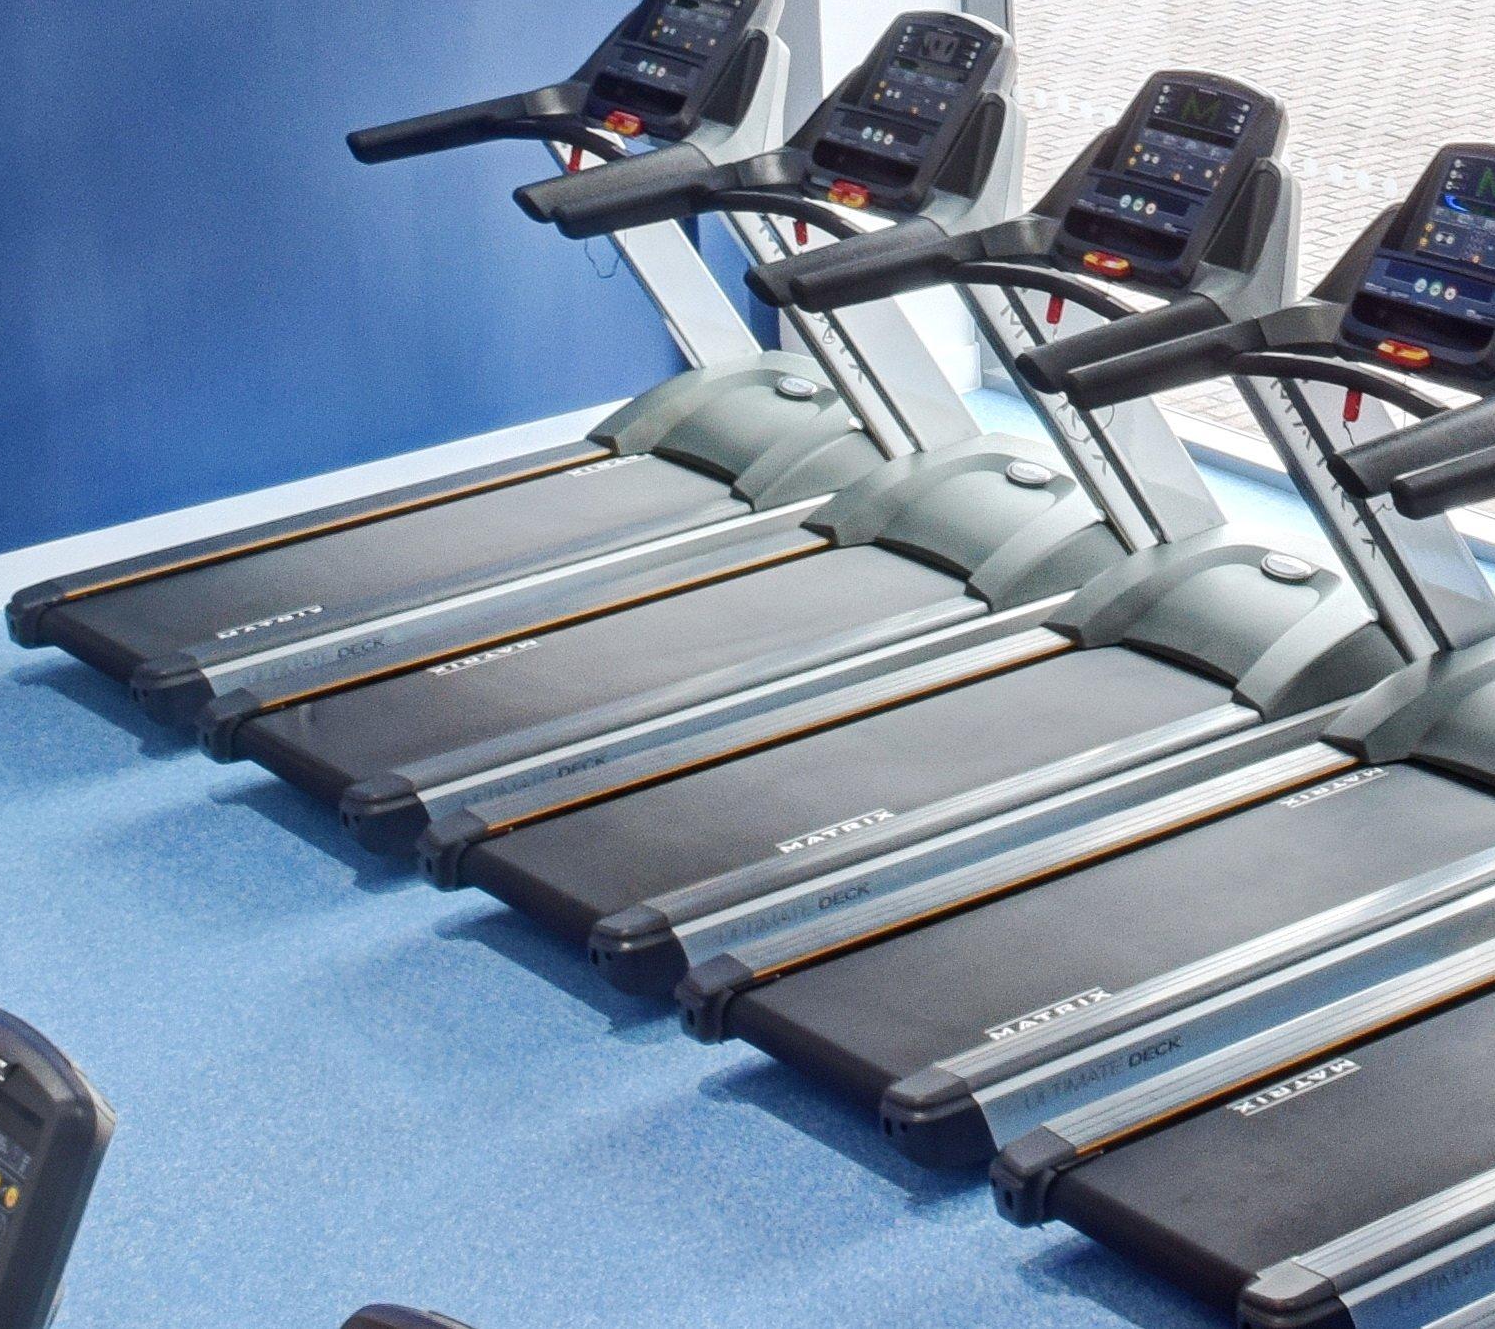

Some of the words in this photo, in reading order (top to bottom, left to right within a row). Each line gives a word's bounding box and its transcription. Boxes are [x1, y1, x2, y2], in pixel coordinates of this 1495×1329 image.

[779, 810, 895, 854] MATRIX
[818, 881, 871, 910] DECK
[989, 989, 1112, 1041] MATRIX
[1128, 1035, 1183, 1069] DECK
